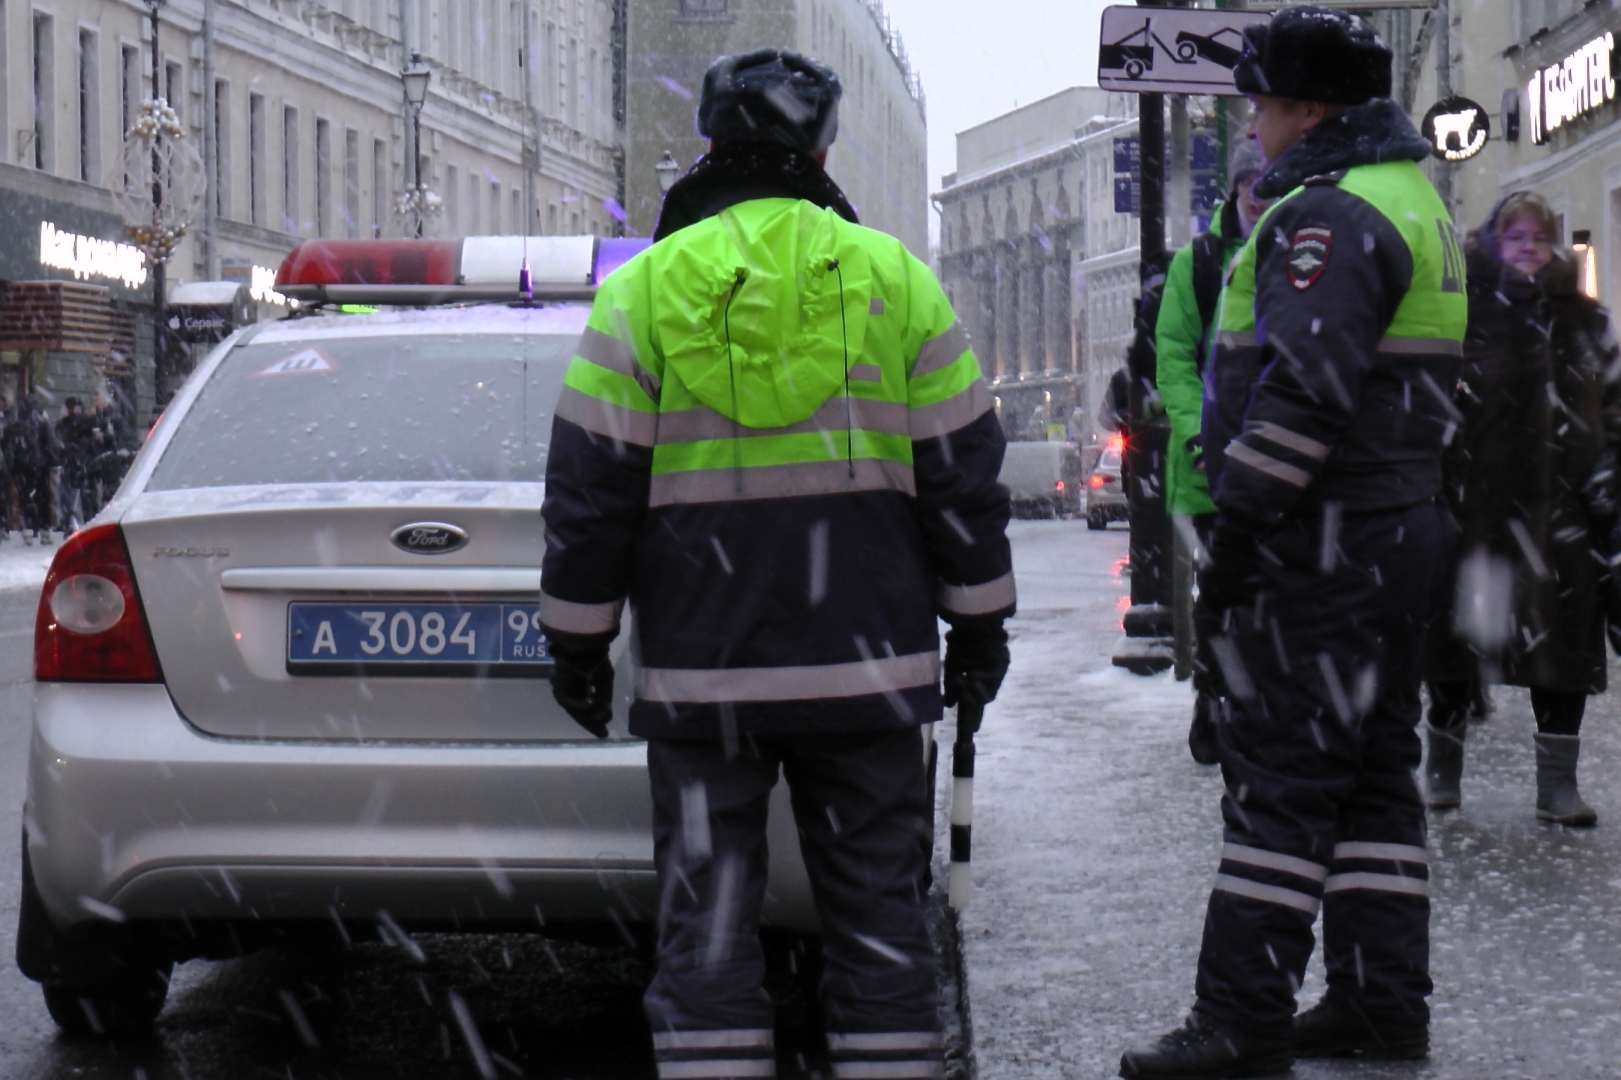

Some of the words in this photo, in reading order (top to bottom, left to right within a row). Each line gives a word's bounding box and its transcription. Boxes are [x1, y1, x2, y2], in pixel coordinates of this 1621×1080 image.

[184, 316, 226, 331] Сервис
[408, 528, 450, 546] Ford
[360, 611, 476, 656] 3084
[513, 645, 546, 658] RUS
